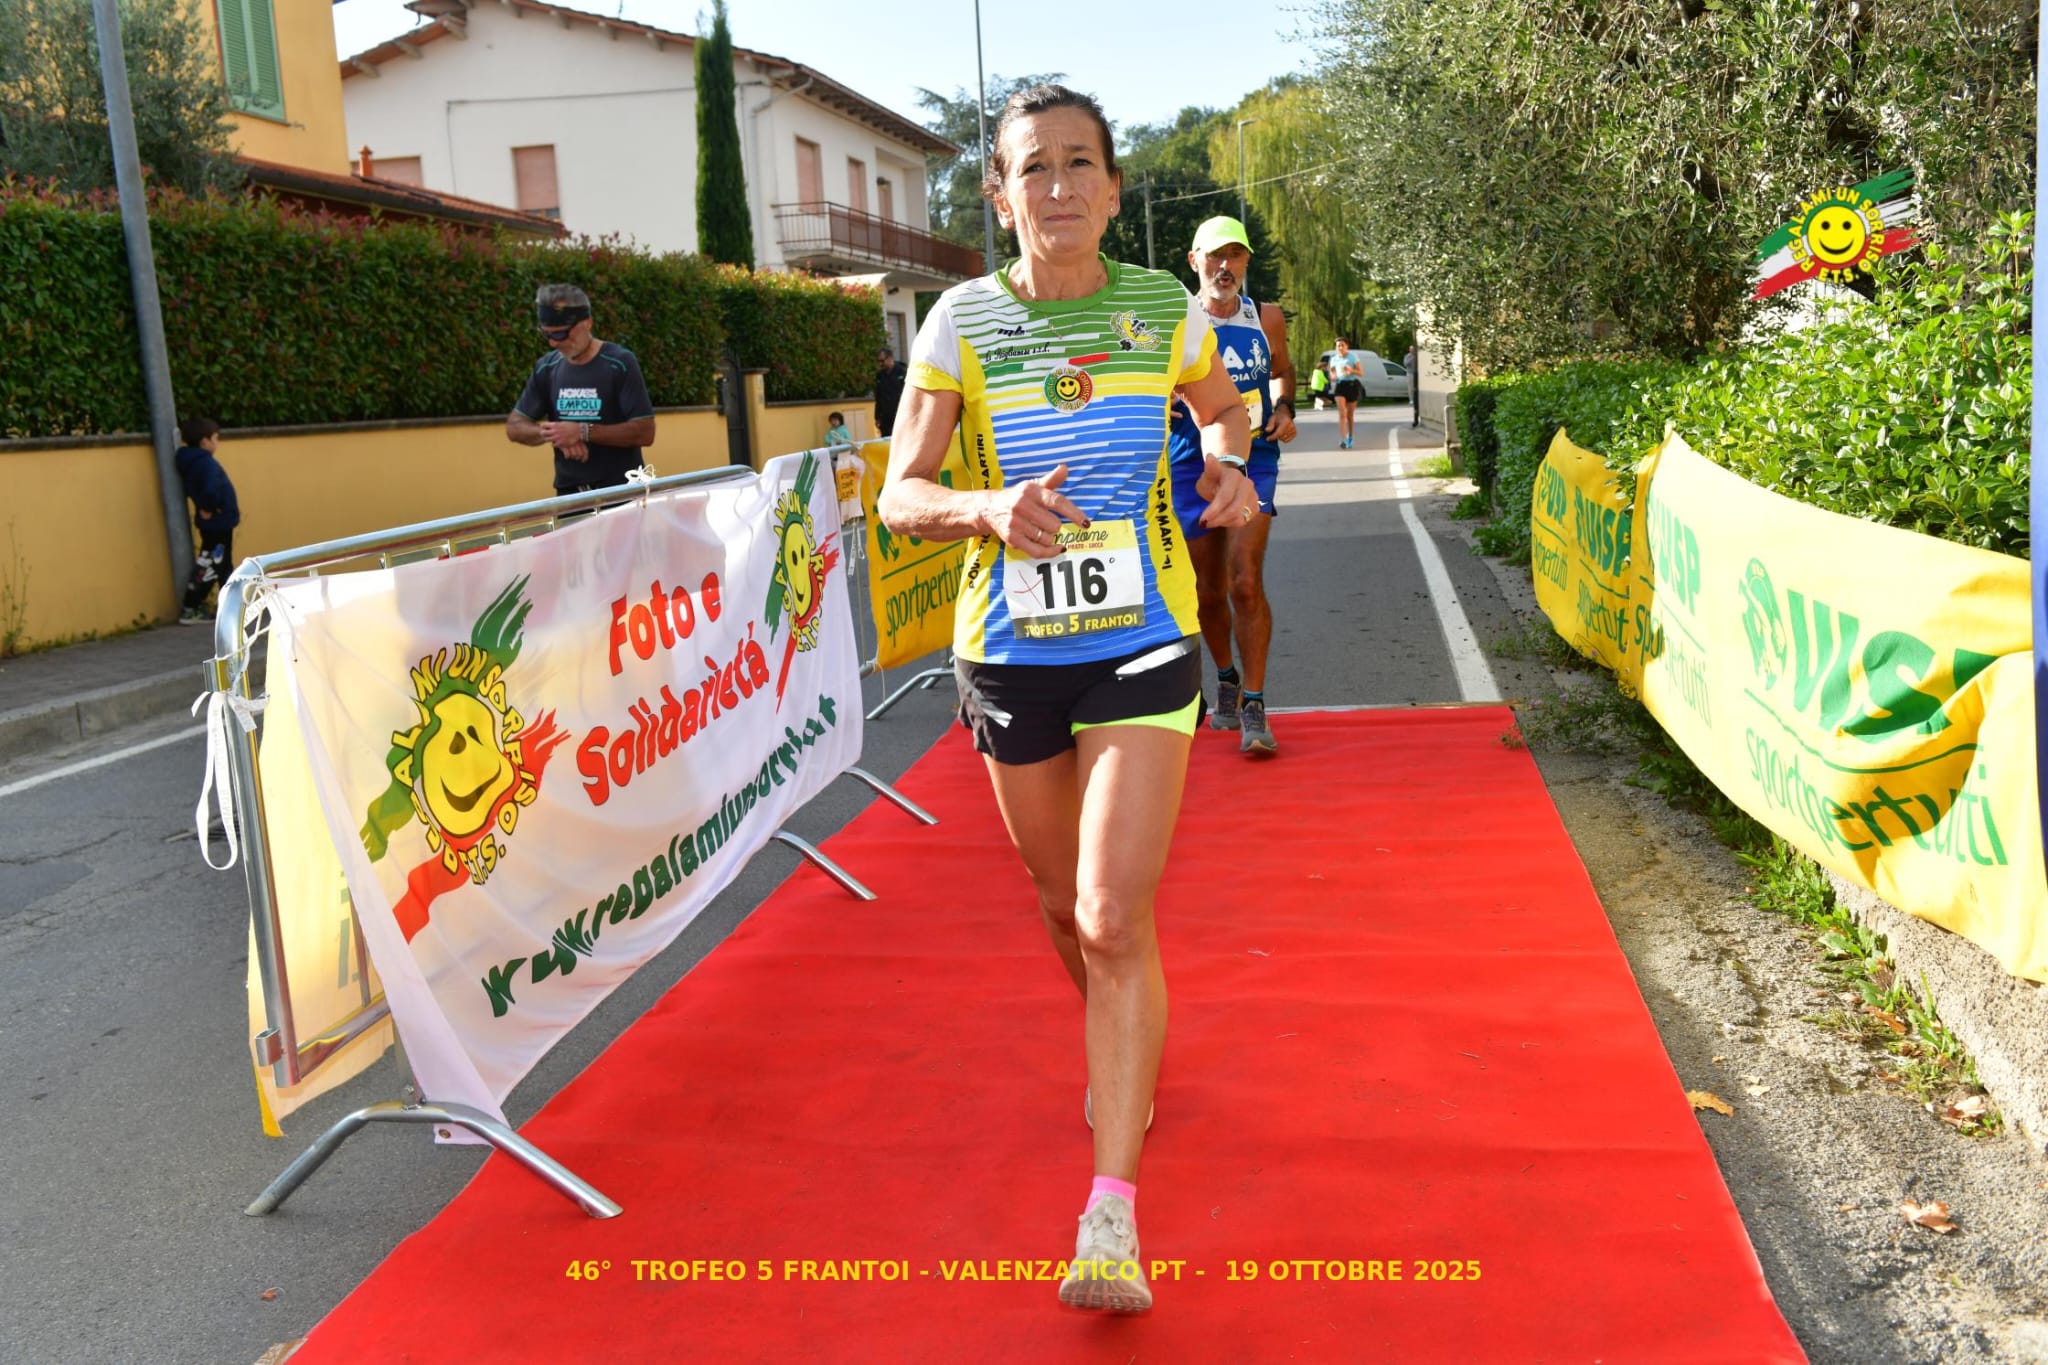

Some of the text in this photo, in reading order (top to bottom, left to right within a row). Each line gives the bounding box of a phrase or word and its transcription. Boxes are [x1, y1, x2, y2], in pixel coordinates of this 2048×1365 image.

[559, 399, 598, 410] EMPOLI
[1036, 558, 1108, 610] 116
[609, 571, 722, 677] Foto e
[1024, 613, 1138, 638] TROFEO 5 FRANTOI
[447, 642, 488, 684] UN
[478, 664, 538, 836] SORRISO
